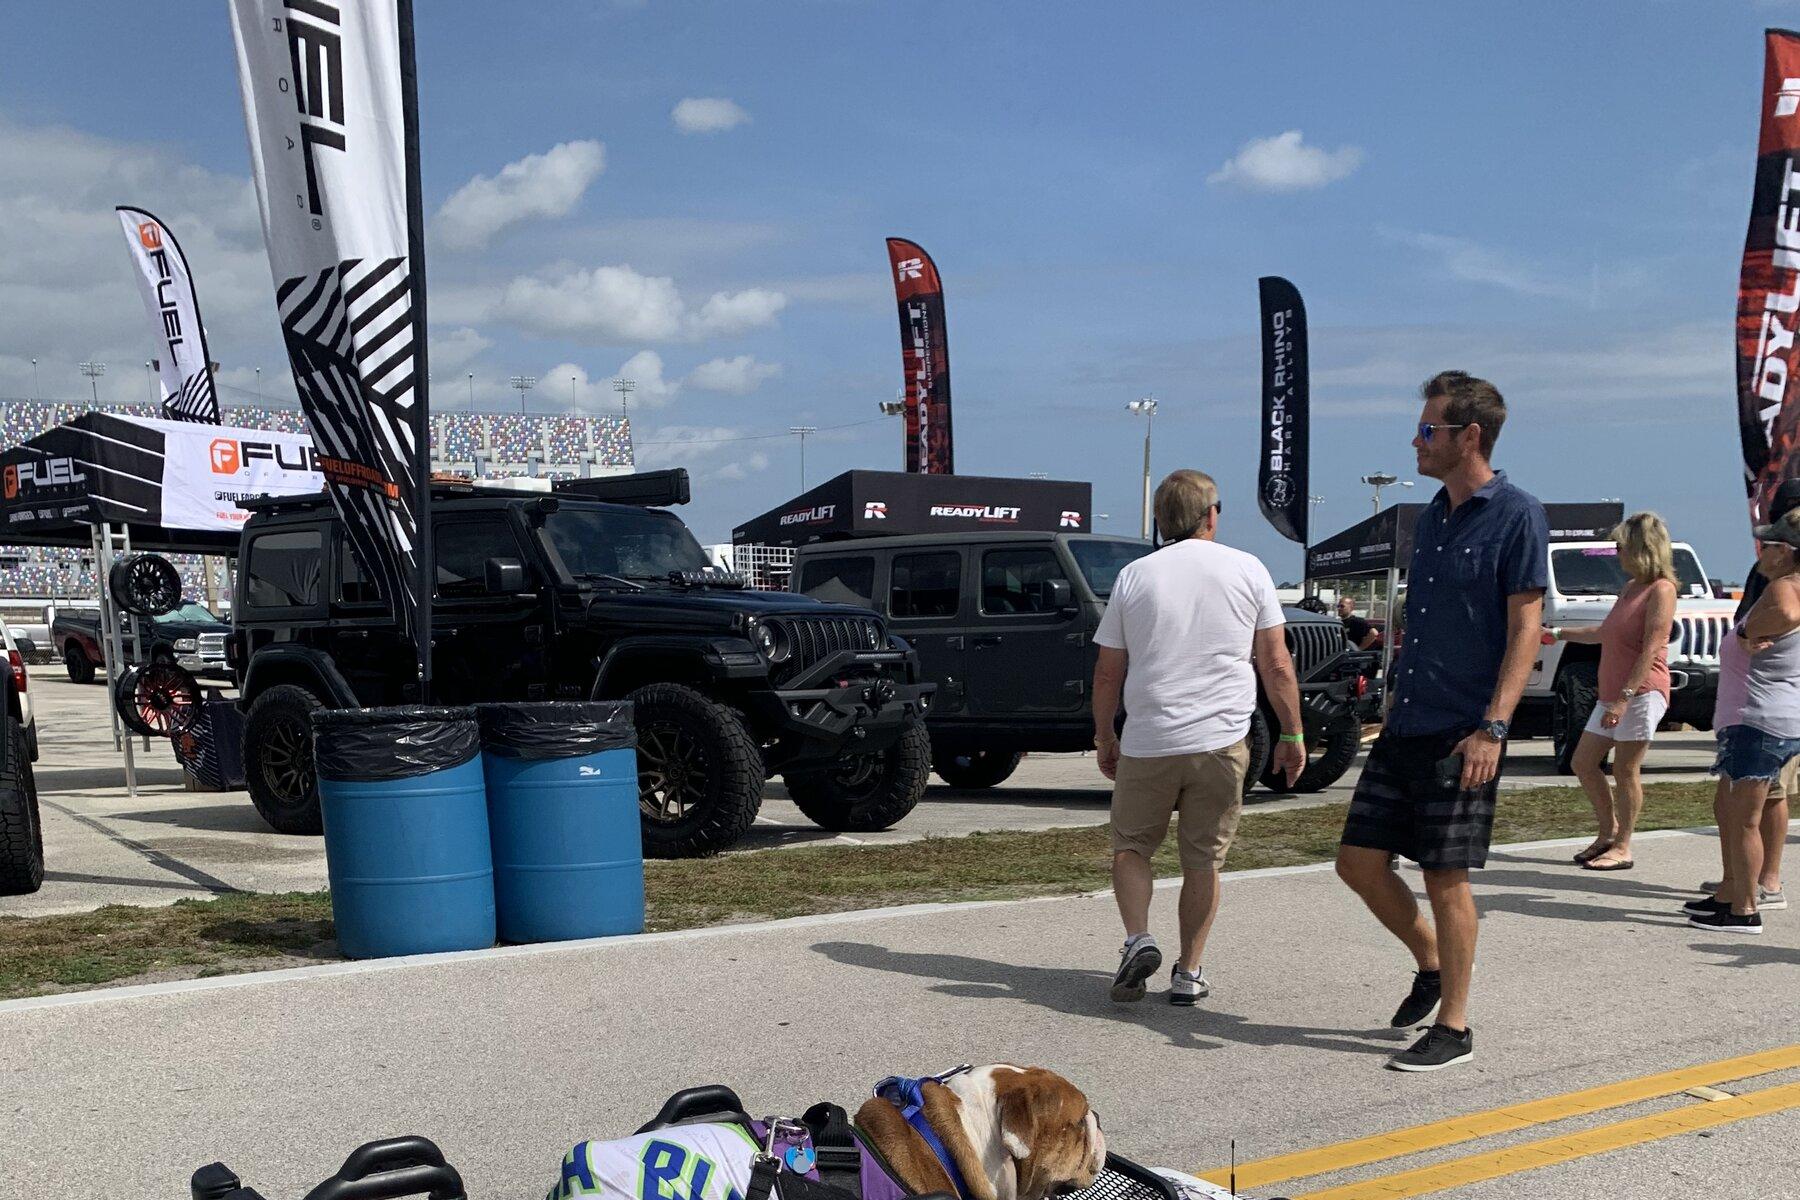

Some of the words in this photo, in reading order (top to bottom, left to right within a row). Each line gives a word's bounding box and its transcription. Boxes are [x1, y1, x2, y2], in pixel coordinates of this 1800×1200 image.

[284, 0, 346, 215] EL
[150, 249, 184, 367] FUEL
[1273, 311, 1286, 387] RHINO
[1285, 309, 1294, 396] ALLOYS
[241, 441, 323, 472] FUE
[1270, 395, 1286, 471] BLACK
[1284, 414, 1293, 471] HARD
[17, 457, 86, 489] FUEL
[780, 504, 836, 526] READYLIFT
[930, 505, 1021, 520] READYLIFT
[1316, 551, 1334, 562] BLACK
[1334, 549, 1352, 558] RHINO
